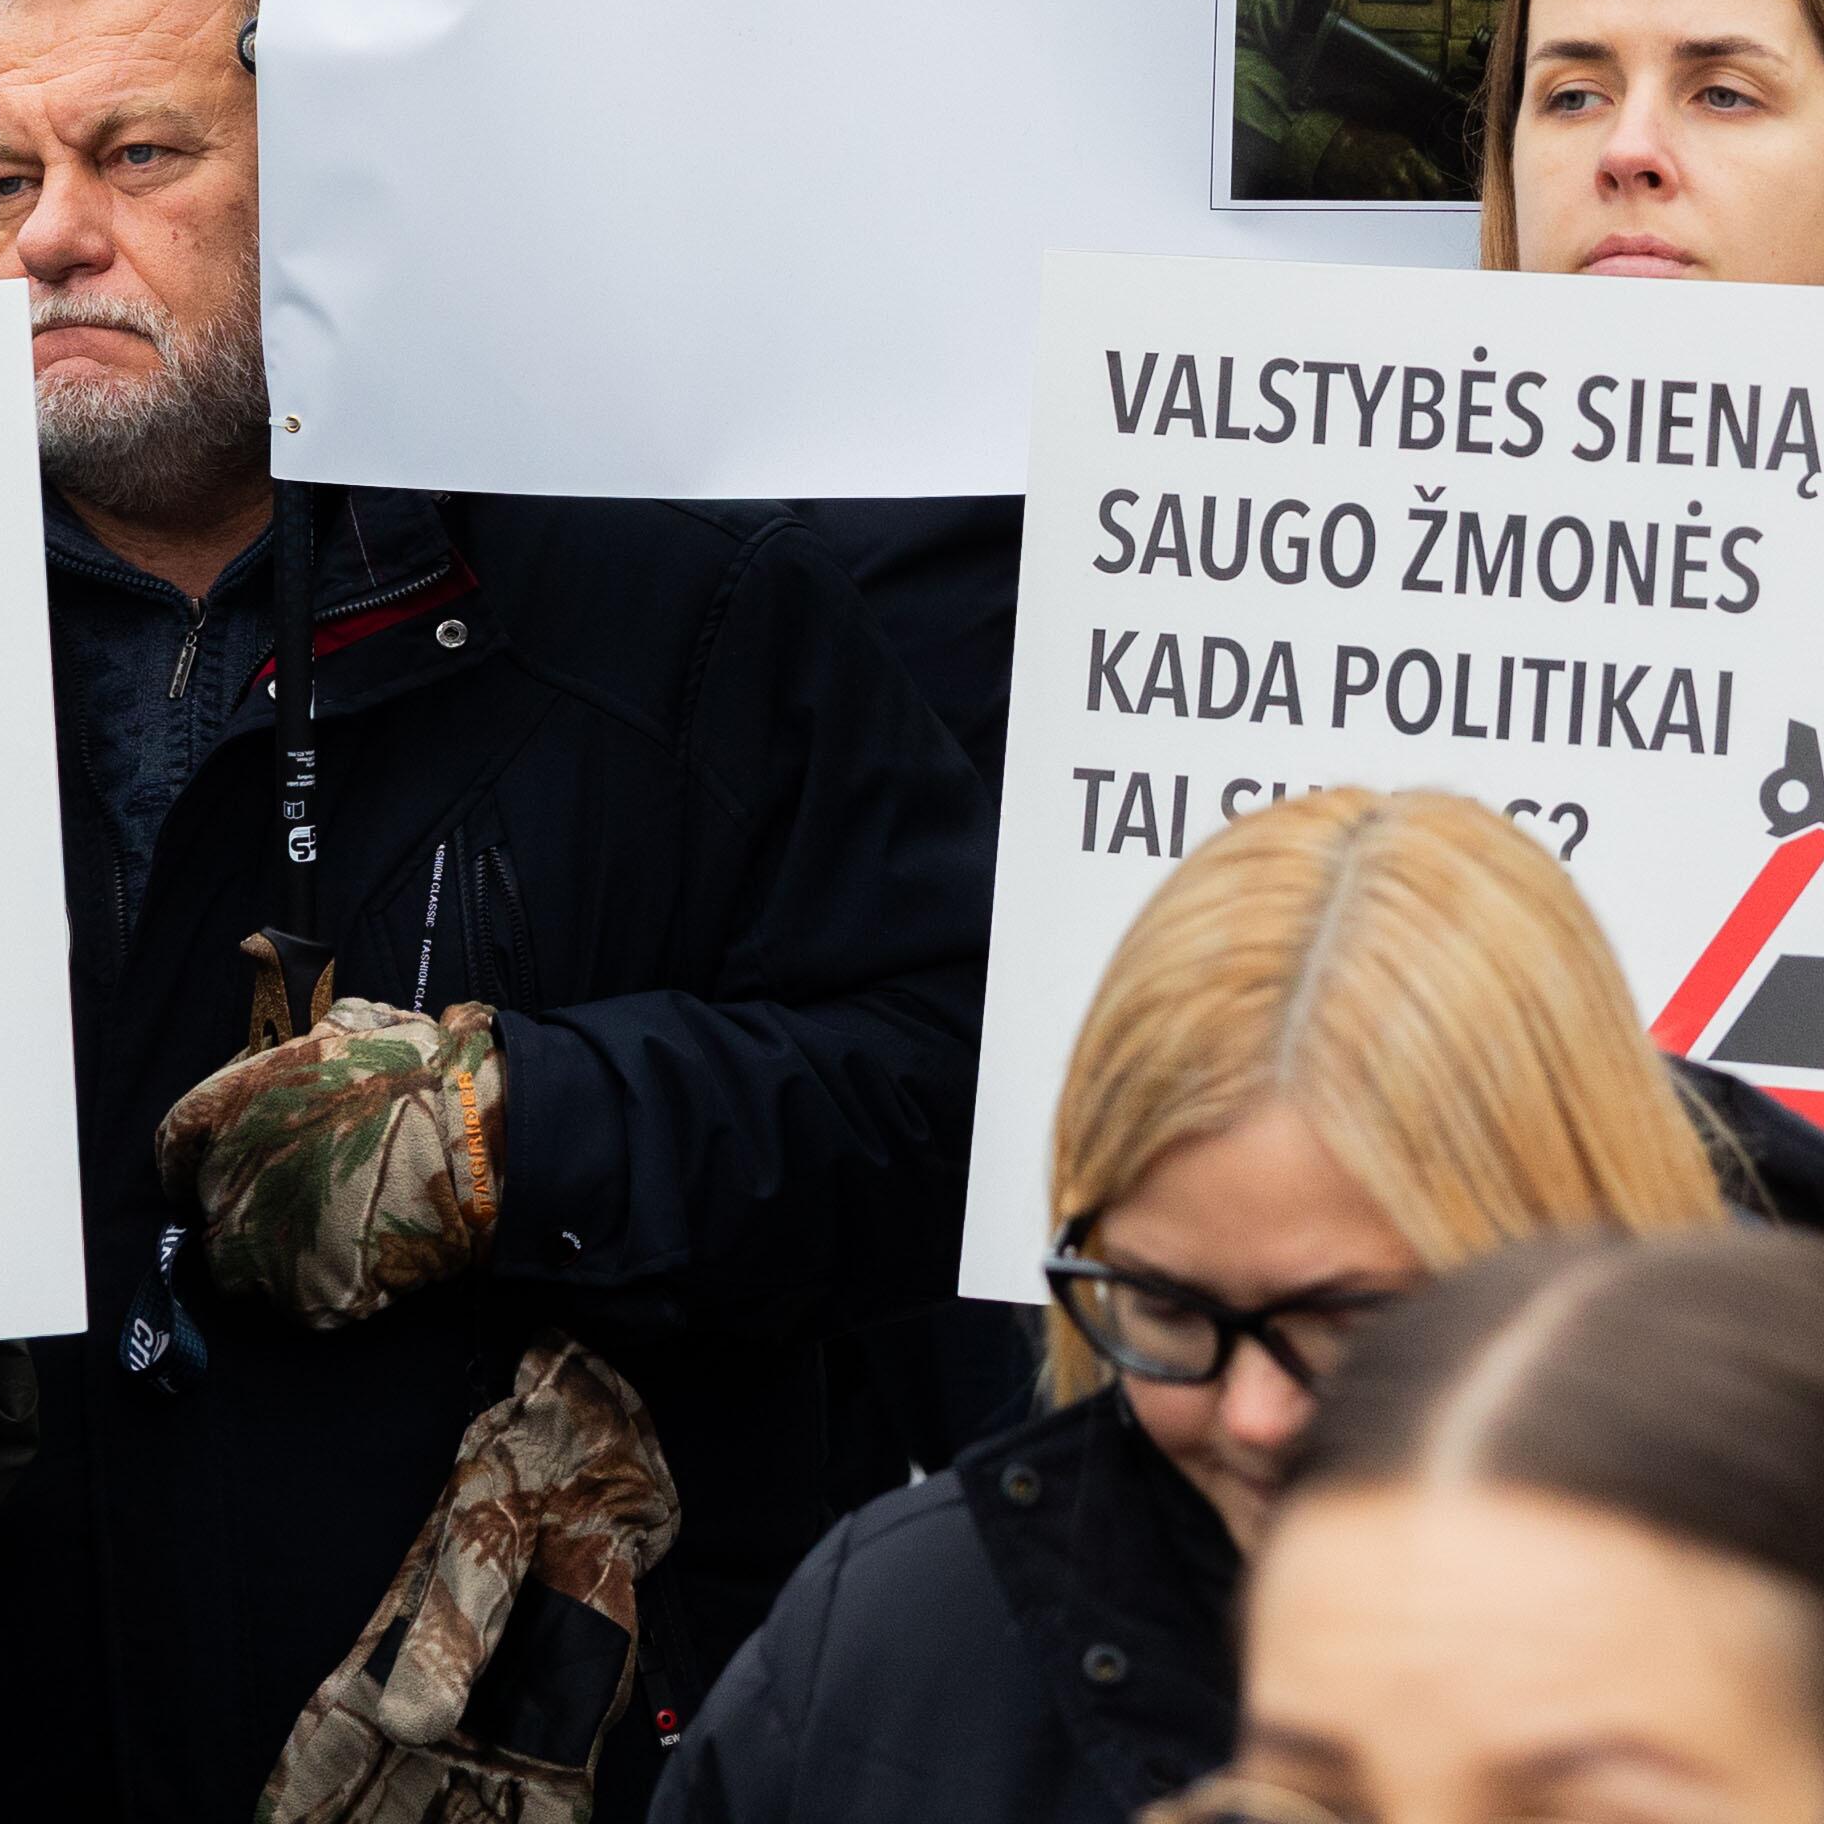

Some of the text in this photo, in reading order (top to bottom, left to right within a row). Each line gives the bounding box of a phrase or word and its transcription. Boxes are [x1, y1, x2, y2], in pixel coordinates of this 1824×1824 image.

[1104, 345, 1824, 500] VALSTYBĖS SIENĄ
[1092, 486, 1764, 617] SAUGO ŽMONĖS
[1085, 629, 1735, 759] KADA POLITIKAI
[1073, 767, 1189, 860] TAI
[425, 881, 441, 928] CLASSIC
[417, 938, 433, 986] FASHION
